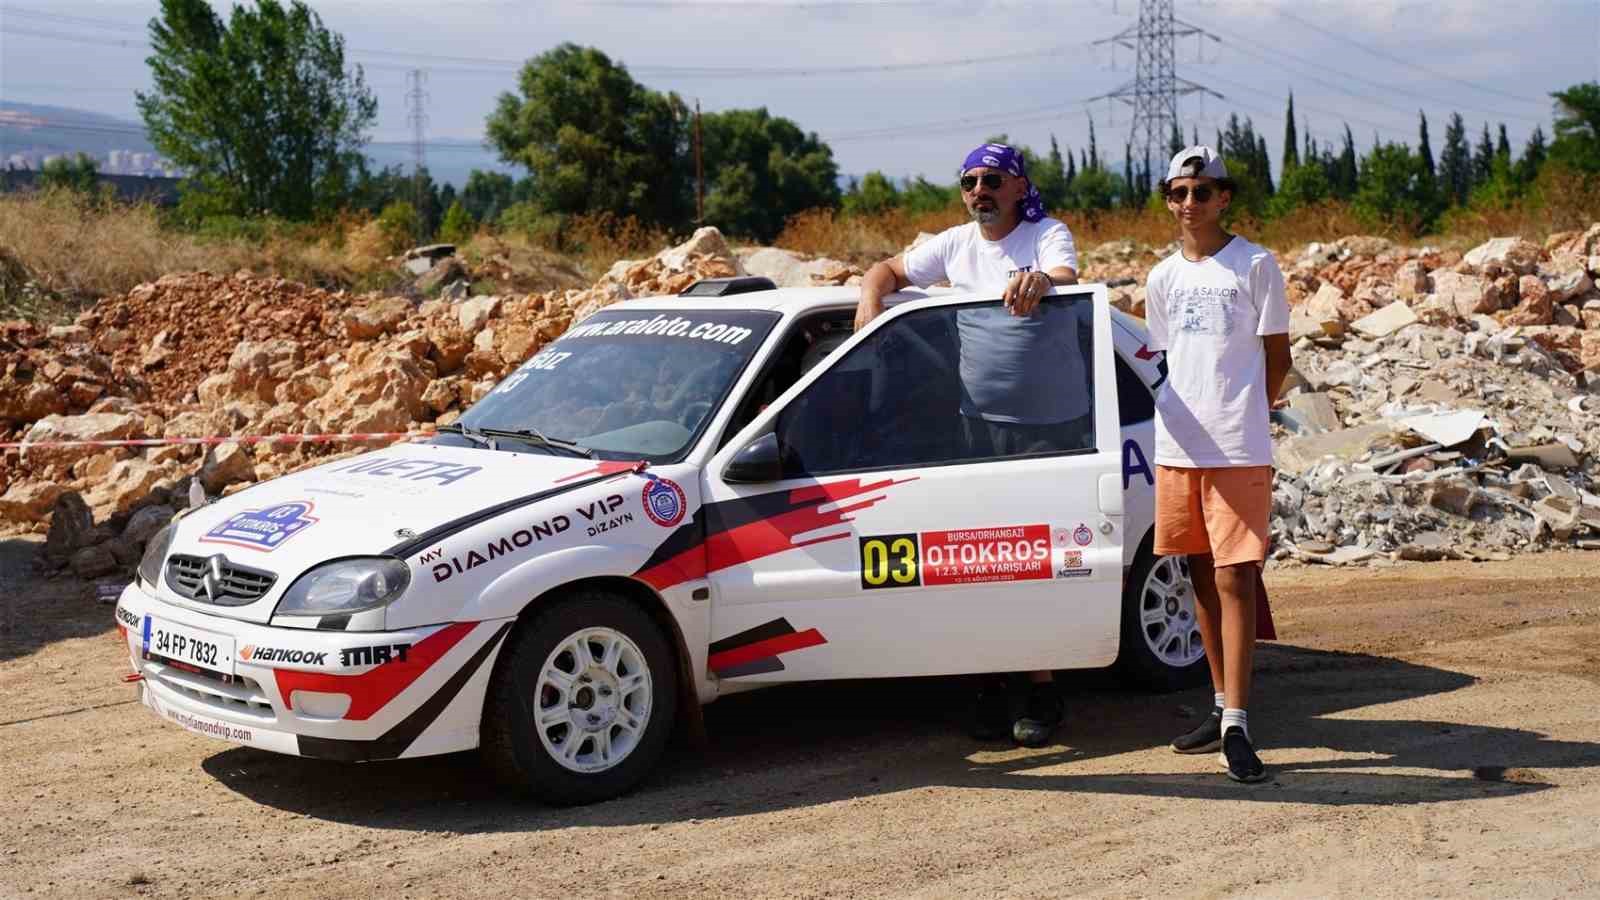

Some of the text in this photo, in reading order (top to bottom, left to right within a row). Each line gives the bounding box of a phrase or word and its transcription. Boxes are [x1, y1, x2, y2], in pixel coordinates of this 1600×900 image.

[432, 514, 571, 583] DIAMOND
[576, 494, 624, 520] VIP
[420, 548, 443, 565] MY
[863, 537, 916, 585] 03
[927, 539, 1048, 567] OTOKROS
[963, 564, 989, 576] AYAK
[156, 630, 170, 652] 34
[172, 633, 187, 656] FP
[189, 638, 218, 666] 7832
[340, 643, 411, 667] MRT
